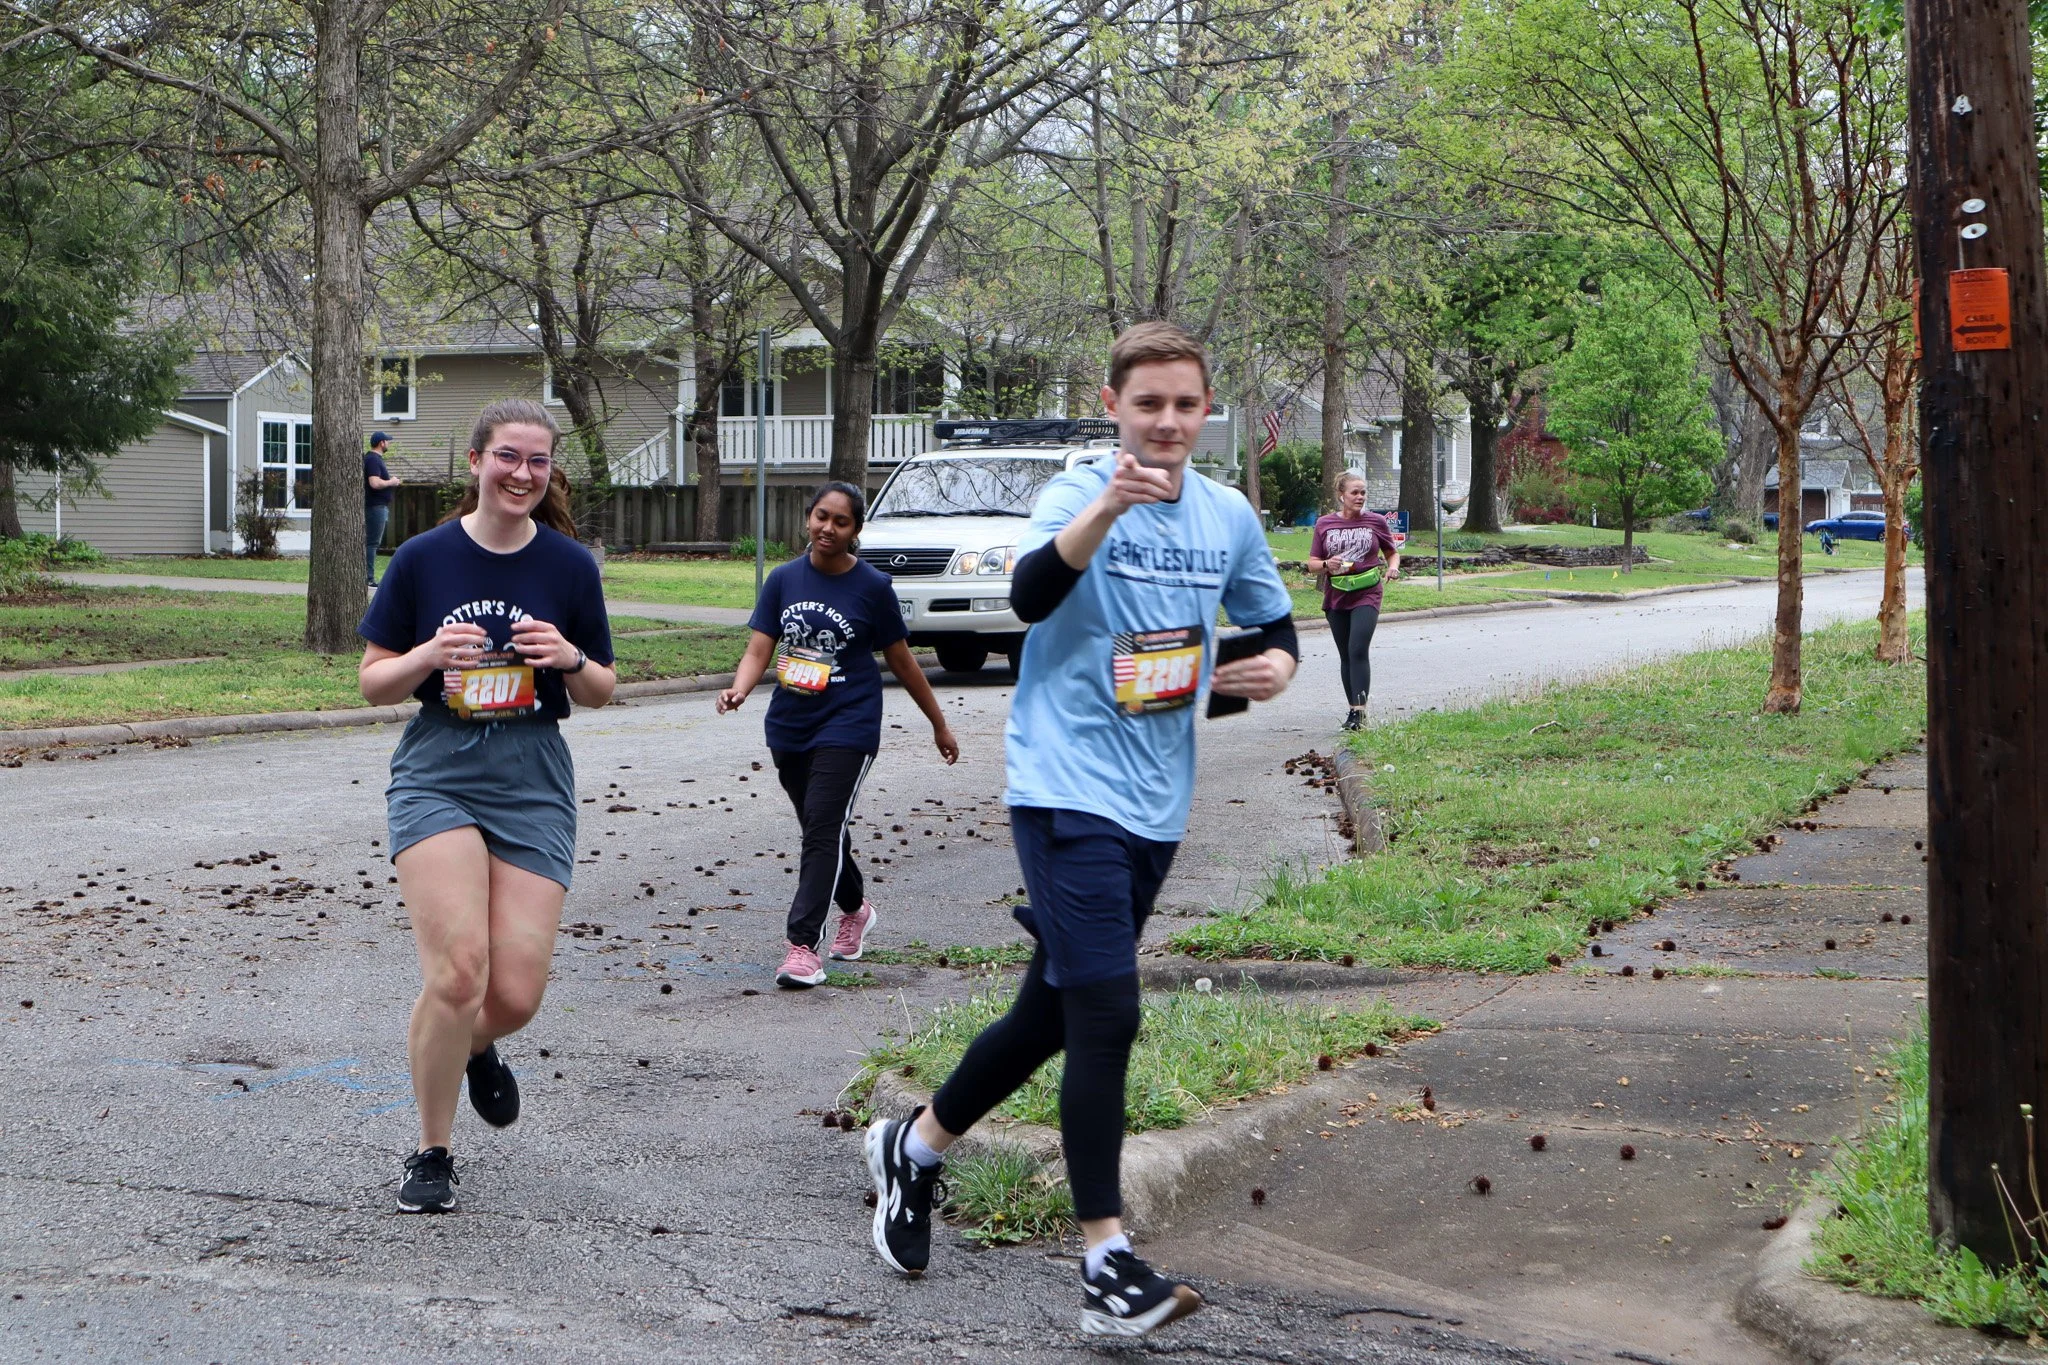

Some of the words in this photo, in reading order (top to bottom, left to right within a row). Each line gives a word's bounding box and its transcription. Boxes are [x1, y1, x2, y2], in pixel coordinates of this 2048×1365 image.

[442, 600, 506, 628] OTTER'S
[825, 607, 856, 640] HOUSE
[463, 671, 522, 706] 2207
